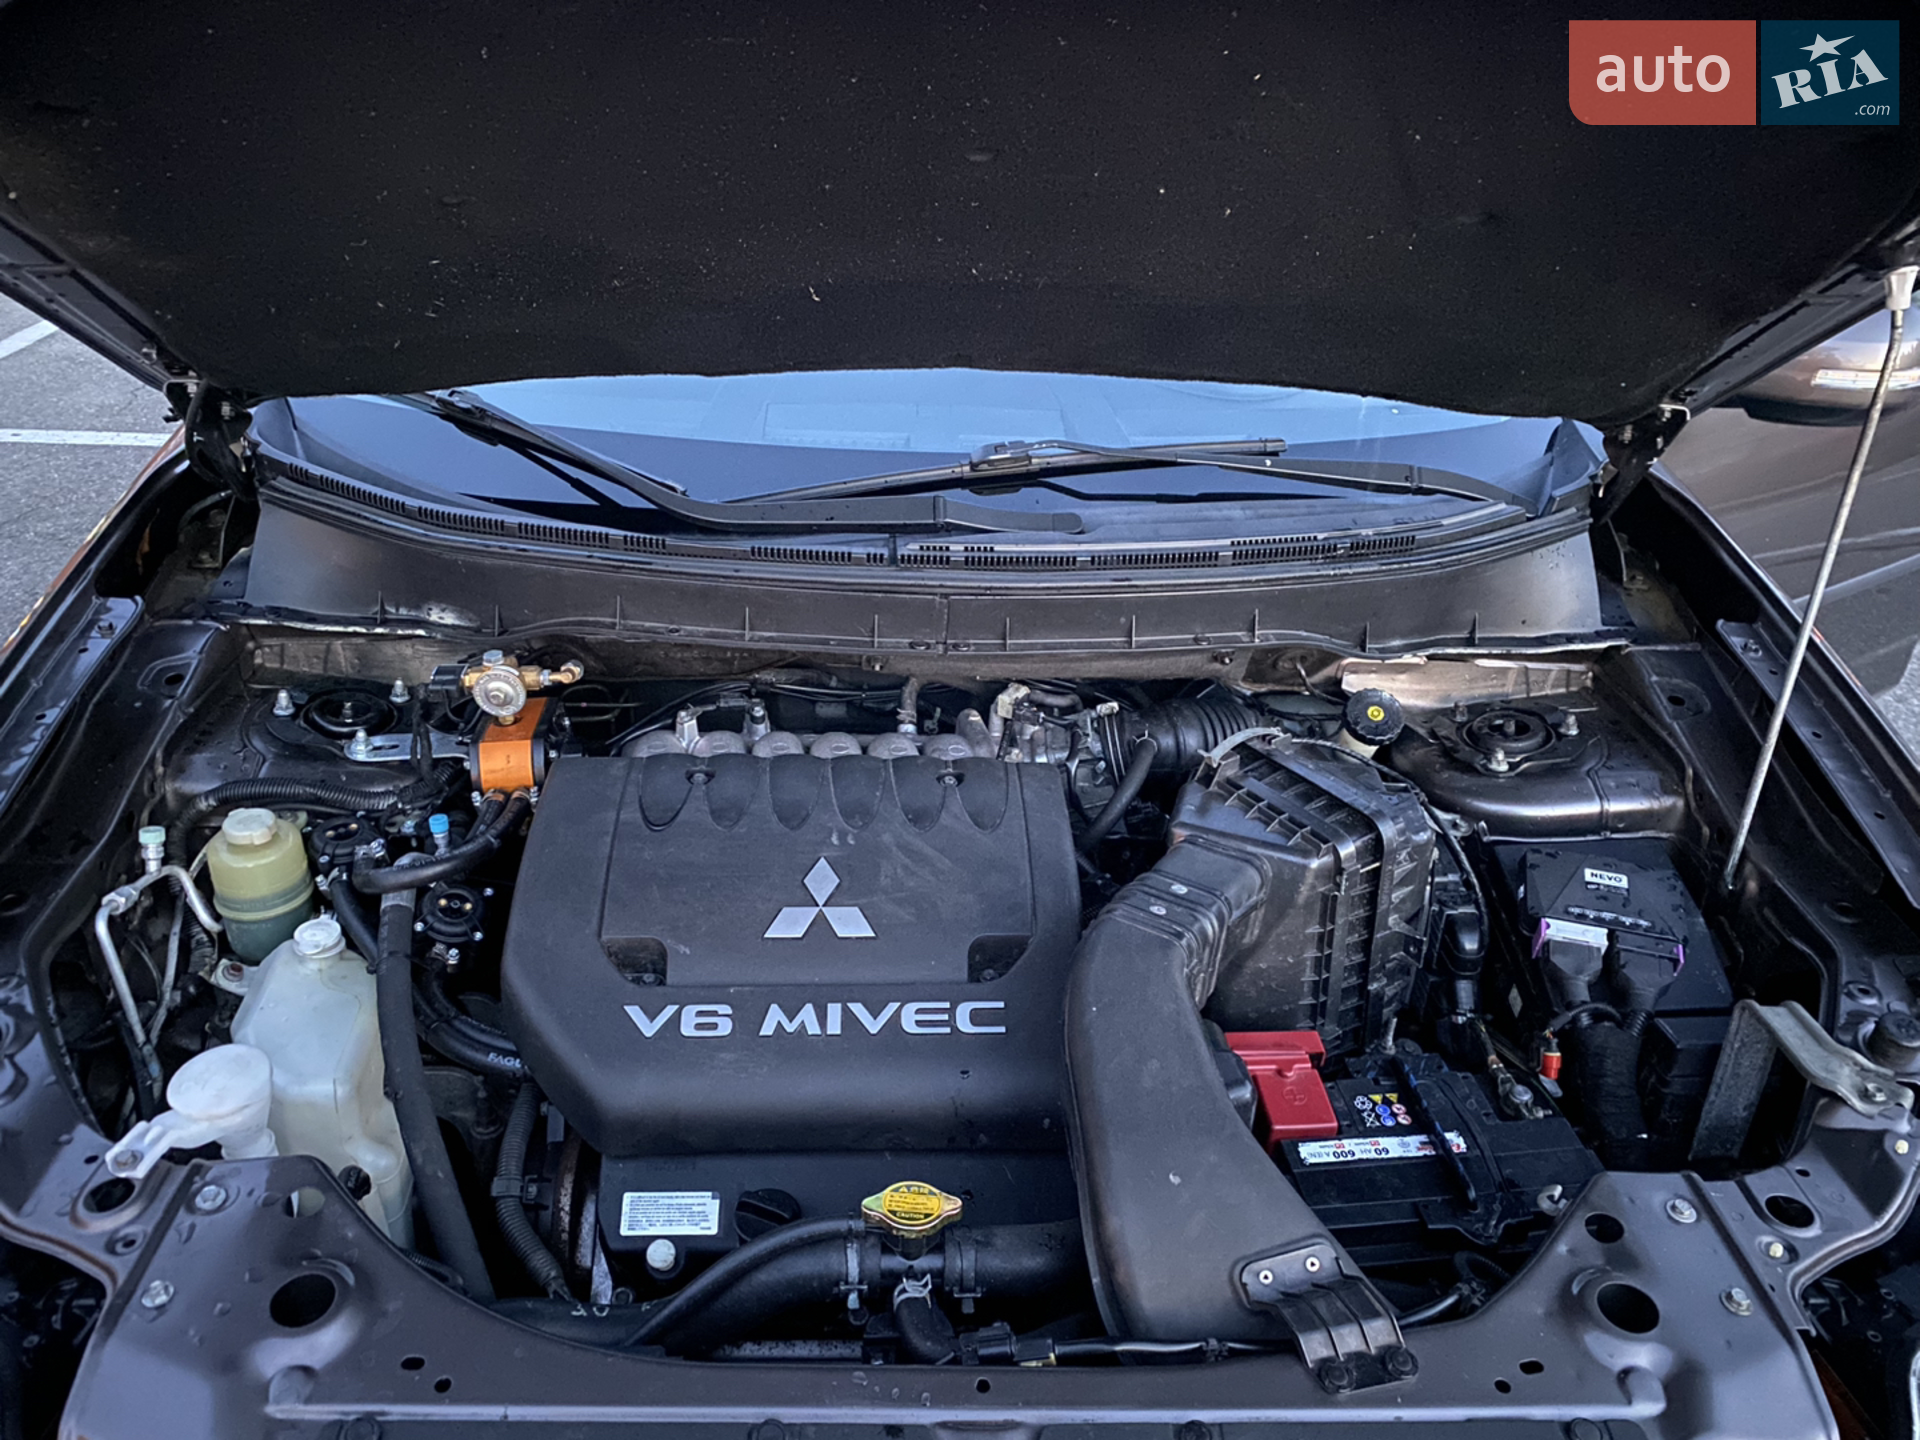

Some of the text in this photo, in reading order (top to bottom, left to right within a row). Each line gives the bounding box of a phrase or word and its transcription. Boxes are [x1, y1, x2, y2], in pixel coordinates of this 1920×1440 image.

[1590, 871, 1622, 883] NEVO
[623, 1001, 1007, 1038] V6 MIVEC
[1332, 1149, 1356, 1159] 600
[1374, 1147, 1390, 1156] 60
